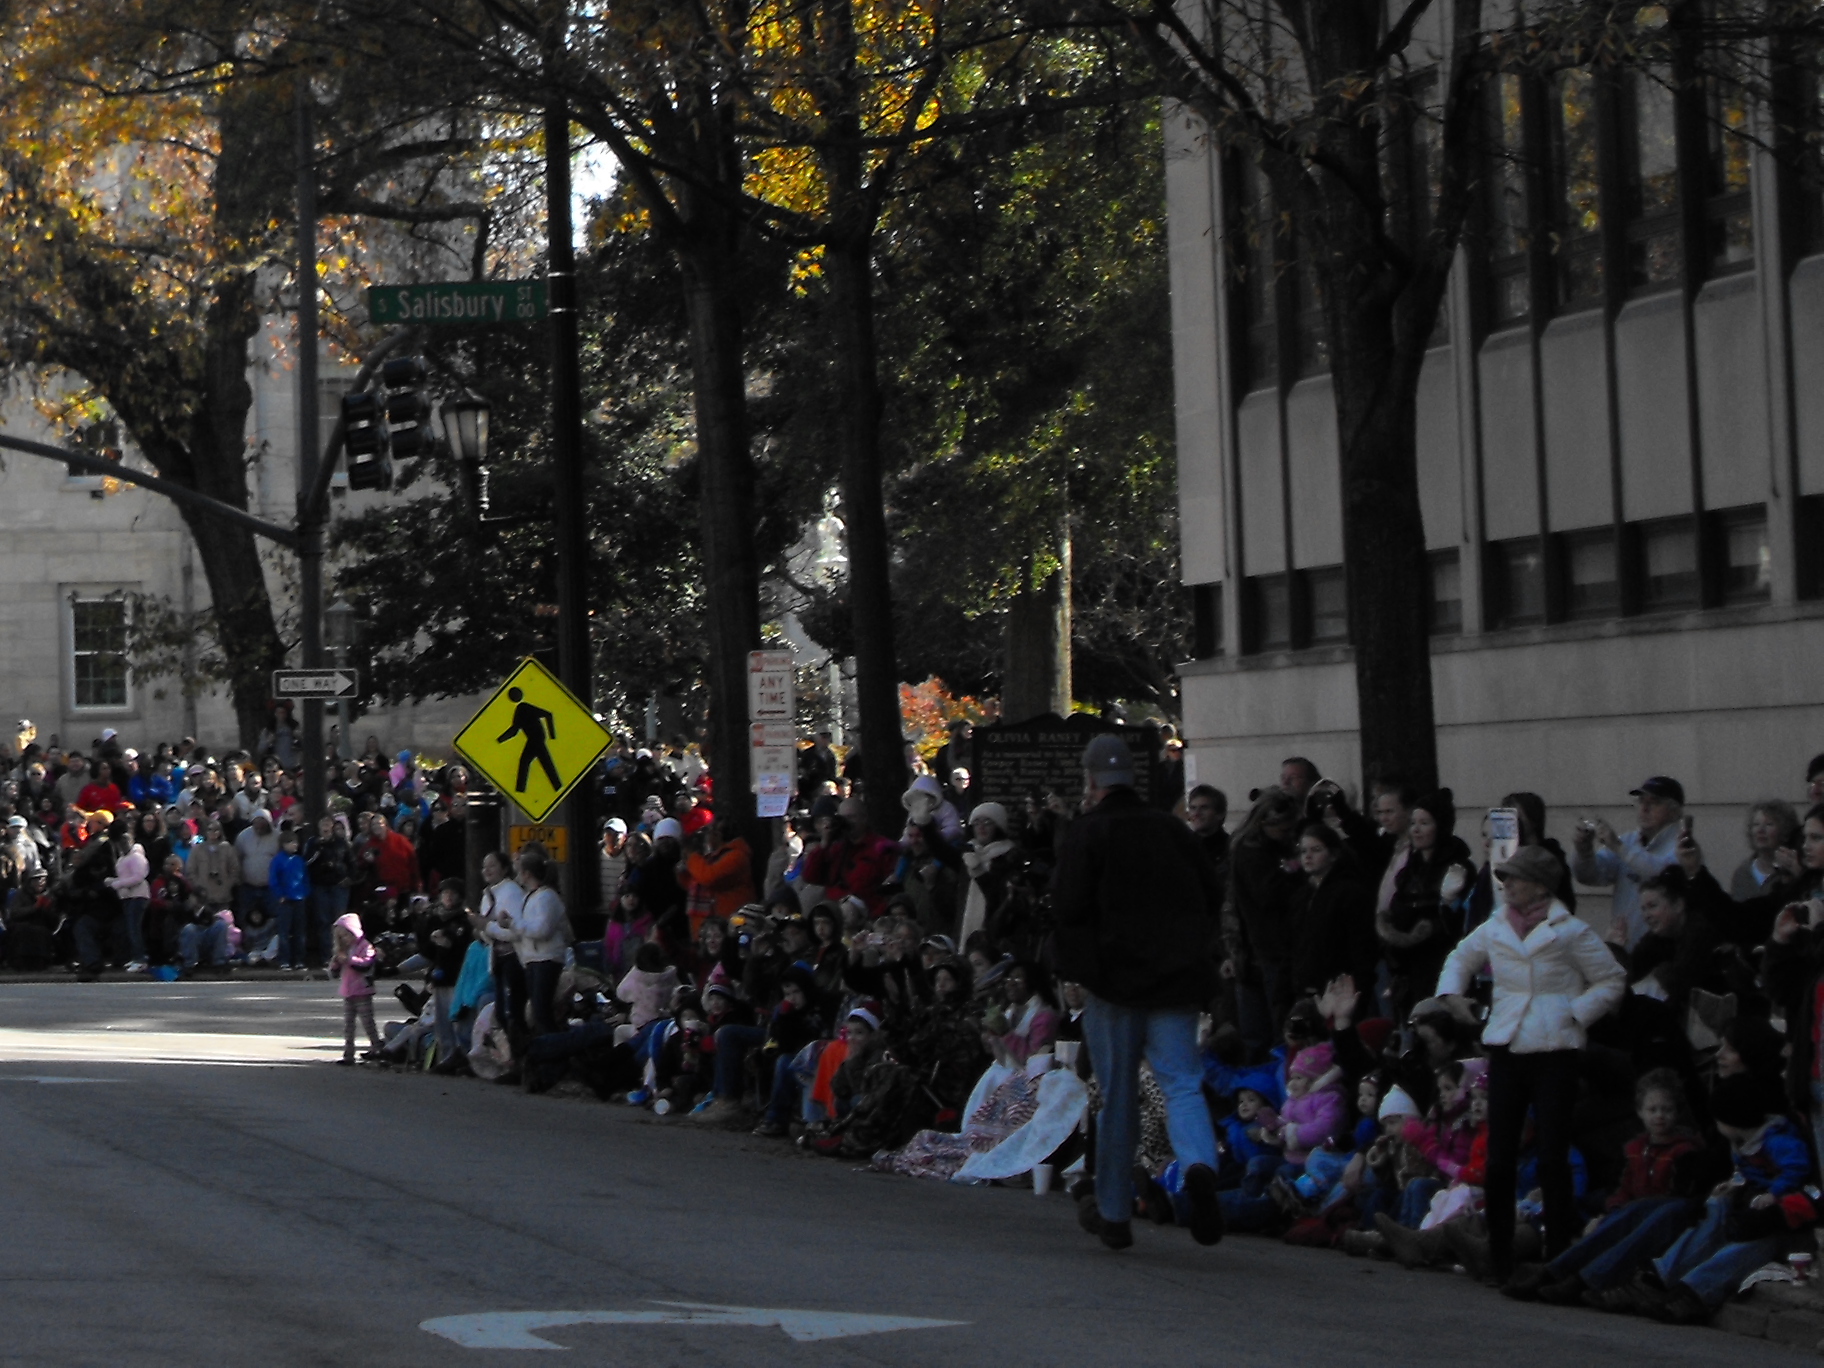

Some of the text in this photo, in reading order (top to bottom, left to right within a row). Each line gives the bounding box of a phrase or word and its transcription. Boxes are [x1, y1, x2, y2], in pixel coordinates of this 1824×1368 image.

[517, 286, 532, 300] ST
[398, 290, 505, 322] Salisbury
[282, 678, 338, 690] ONE WAY
[760, 677, 784, 689] ANY
[759, 692, 785, 705] TIME
[986, 733, 1031, 744] OLIVIA
[1038, 733, 1082, 743] RANEY
[520, 827, 555, 842] LOOK
